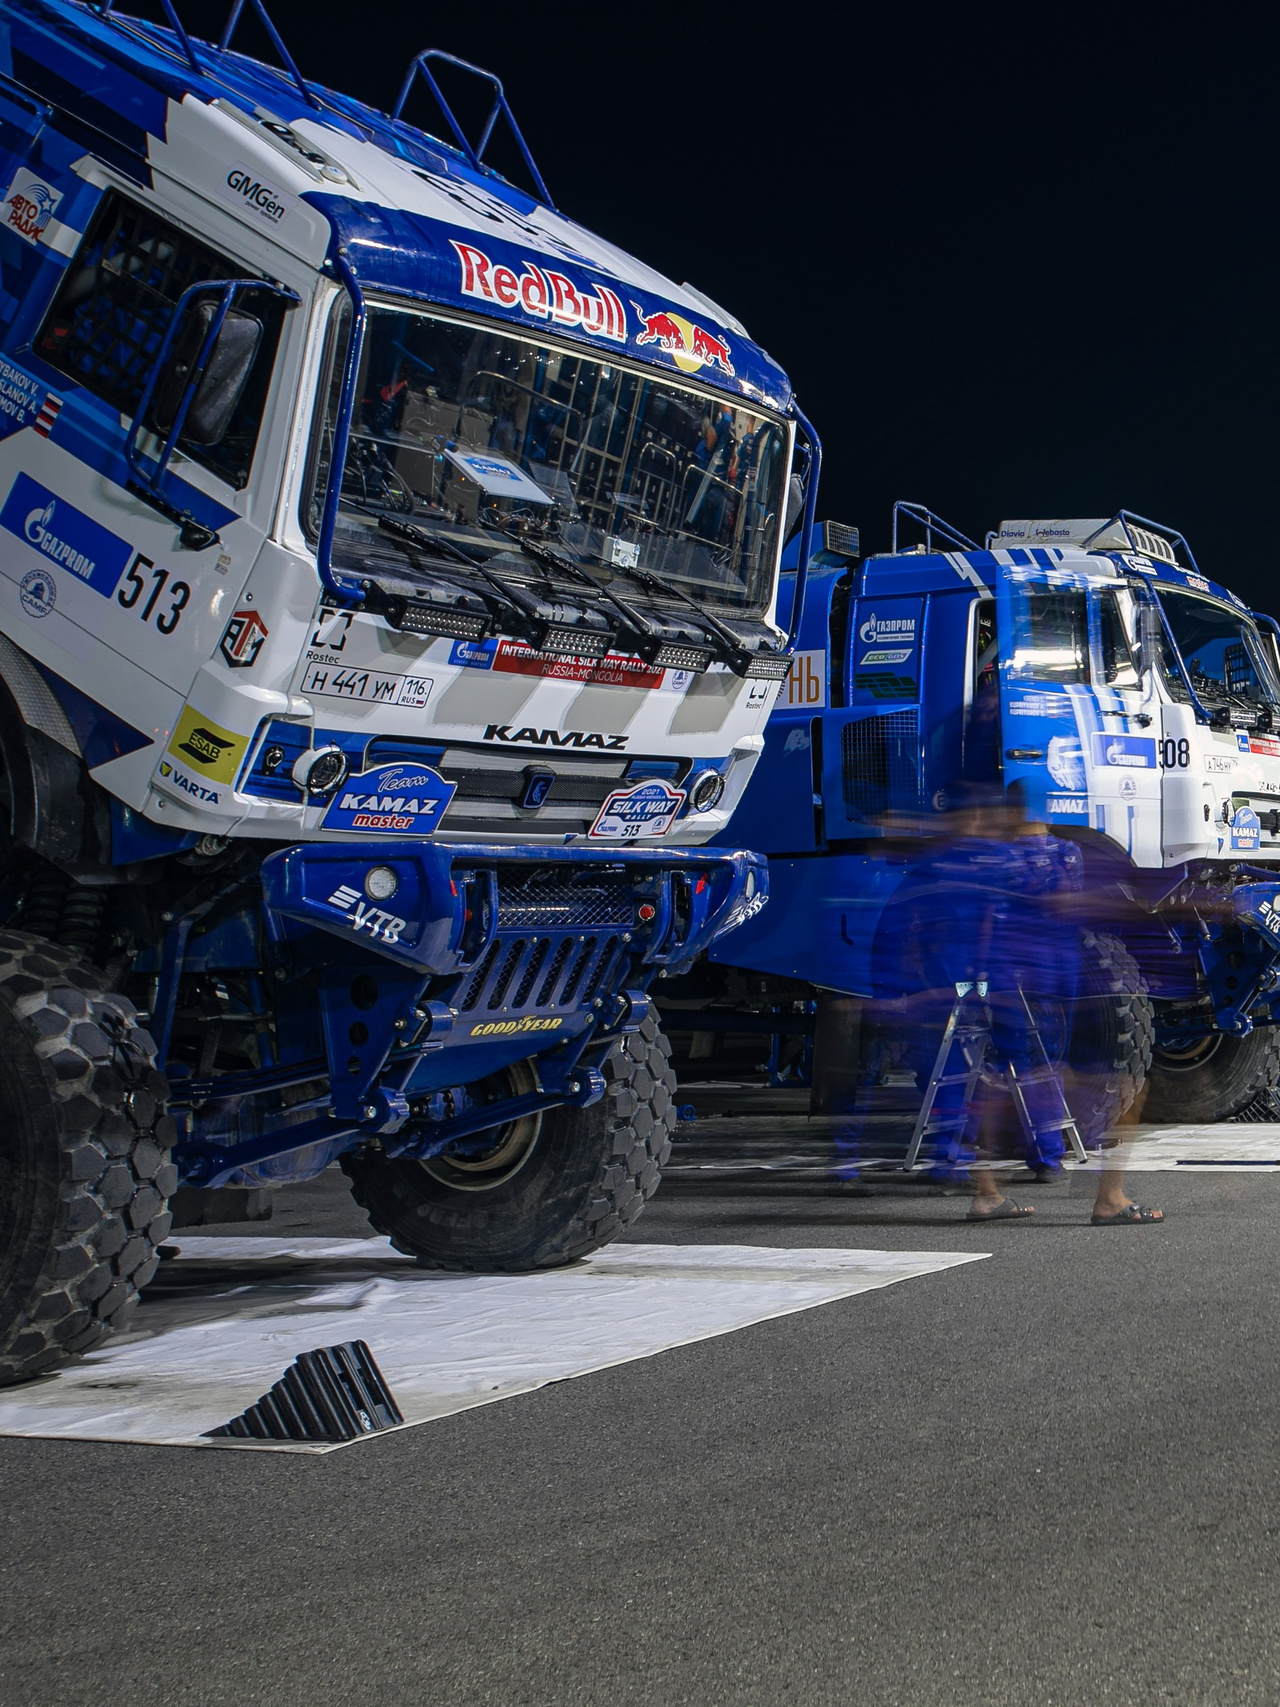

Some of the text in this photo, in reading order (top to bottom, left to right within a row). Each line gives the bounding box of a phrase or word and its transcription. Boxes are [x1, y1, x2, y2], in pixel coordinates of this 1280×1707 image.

[226, 169, 286, 219] GMGen
[7, 193, 38, 220] АВТО
[448, 239, 628, 344] Red Bull
[0, 359, 31, 390] YBAKOV
[0, 394, 19, 416] MOV
[1000, 528, 1070, 538] Diavia Webasto
[40, 531, 96, 580] GAZPROM
[117, 552, 191, 635] 513
[876, 619, 915, 632] ГАЗПРОМ
[305, 650, 341, 665] Rostec
[600, 657, 622, 670] WAY
[620, 660, 648, 673] RALLY
[331, 669, 370, 697] 441
[406, 679, 427, 695] 116
[401, 696, 417, 705] RUS
[188, 731, 221, 759] ESAB
[483, 724, 630, 750] KAMAZ
[1159, 738, 1190, 768] 508
[172, 769, 221, 805] VARTA
[378, 768, 429, 793] Team
[339, 793, 439, 815] KAMAZ
[609, 800, 677, 814] SILK WAY
[1046, 798, 1086, 814] AMAZ
[352, 813, 415, 830] master
[620, 824, 642, 837] 513
[1232, 827, 1259, 838] KAMAZ
[353, 901, 407, 944] VTB
[470, 1015, 563, 1036] GOODYEAR
